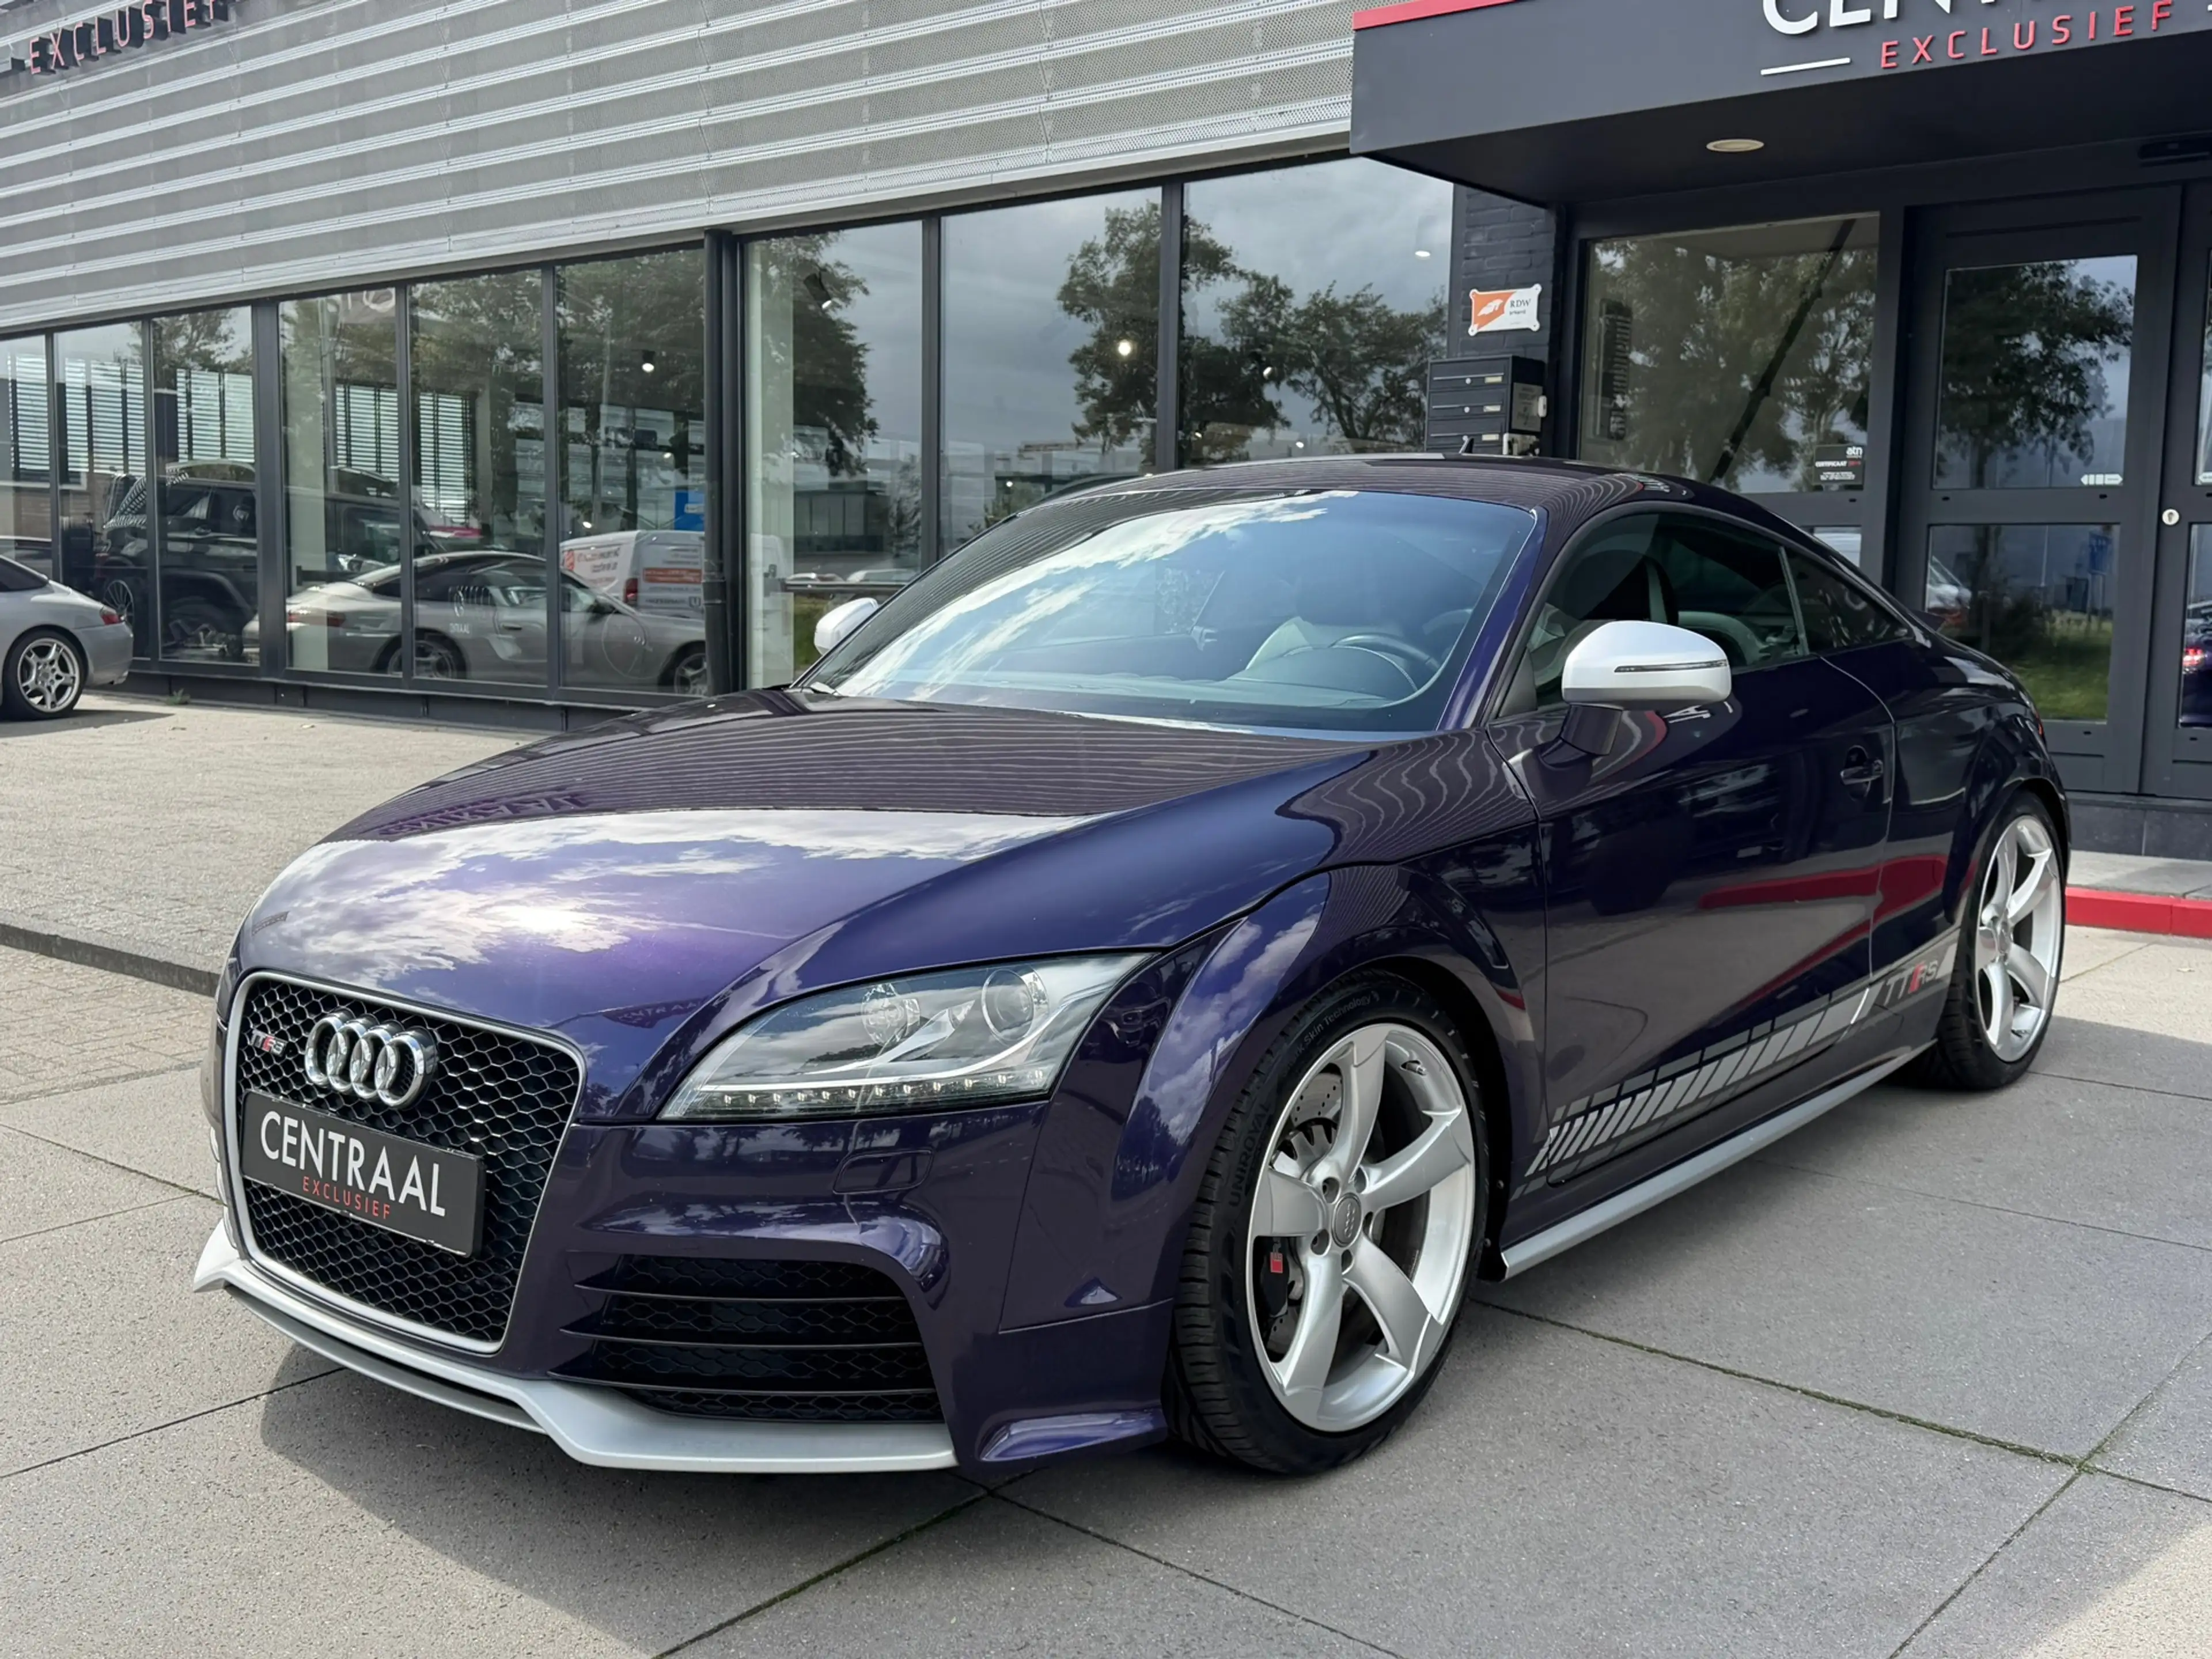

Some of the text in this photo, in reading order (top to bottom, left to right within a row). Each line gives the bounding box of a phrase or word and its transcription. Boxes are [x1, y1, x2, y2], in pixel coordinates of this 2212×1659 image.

[1881, 0, 2173, 69] EXCLUSIEF
[1510, 298, 1532, 308] RDW
[1303, 995, 1372, 1045] Skin Technology
[260, 1110, 446, 1217] CENTRAAL
[1228, 1102, 1271, 1207] UNIROYAL
[302, 1176, 391, 1219] EXCLUSIEF
